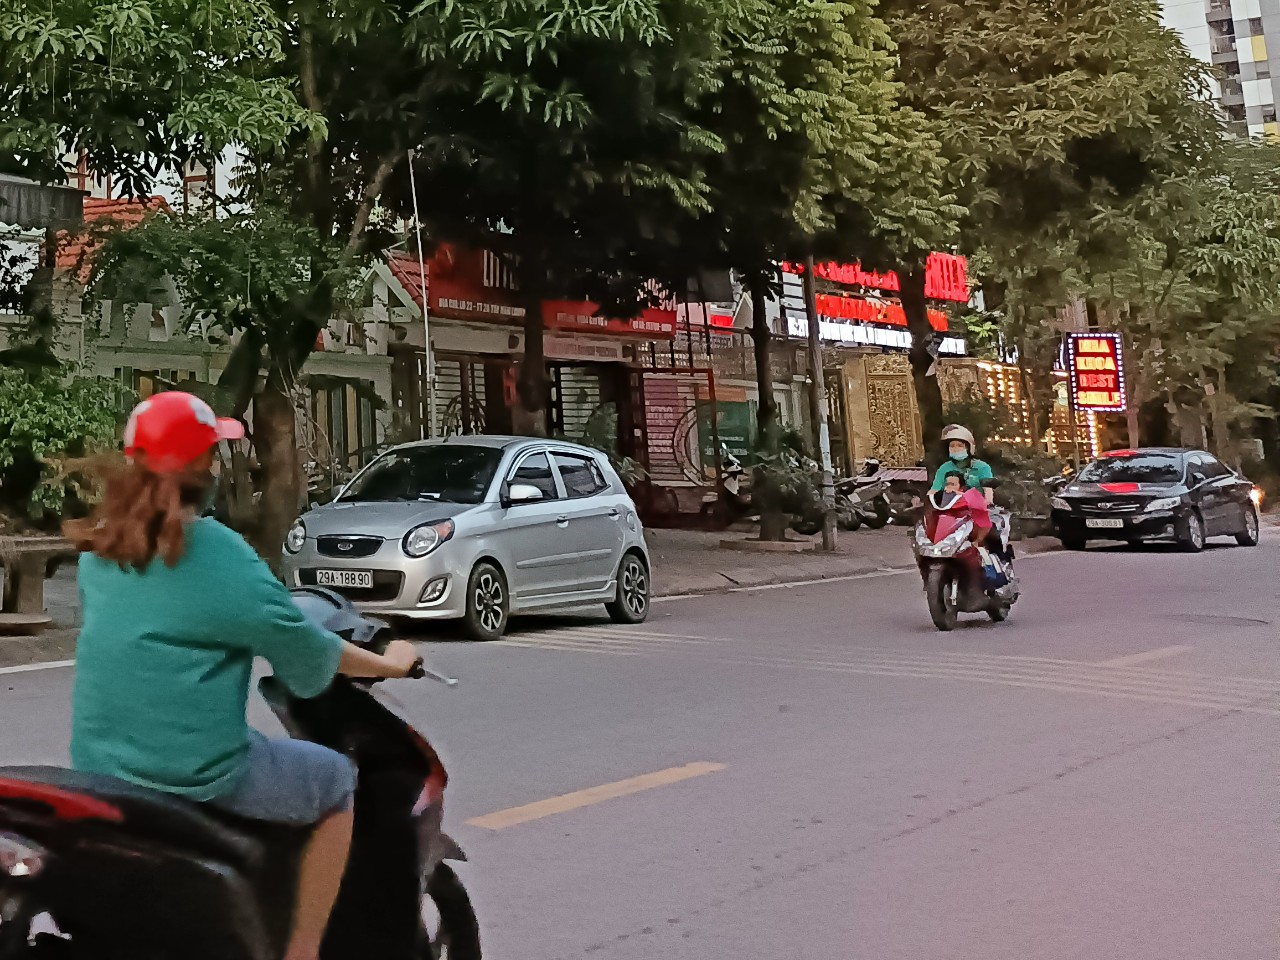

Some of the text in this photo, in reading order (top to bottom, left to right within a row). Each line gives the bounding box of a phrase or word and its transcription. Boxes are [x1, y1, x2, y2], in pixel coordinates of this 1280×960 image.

[1076, 356, 1116, 370] KHOA
[1077, 390, 1121, 405] SMILE
[318, 570, 370, 586] 29A-188.90
